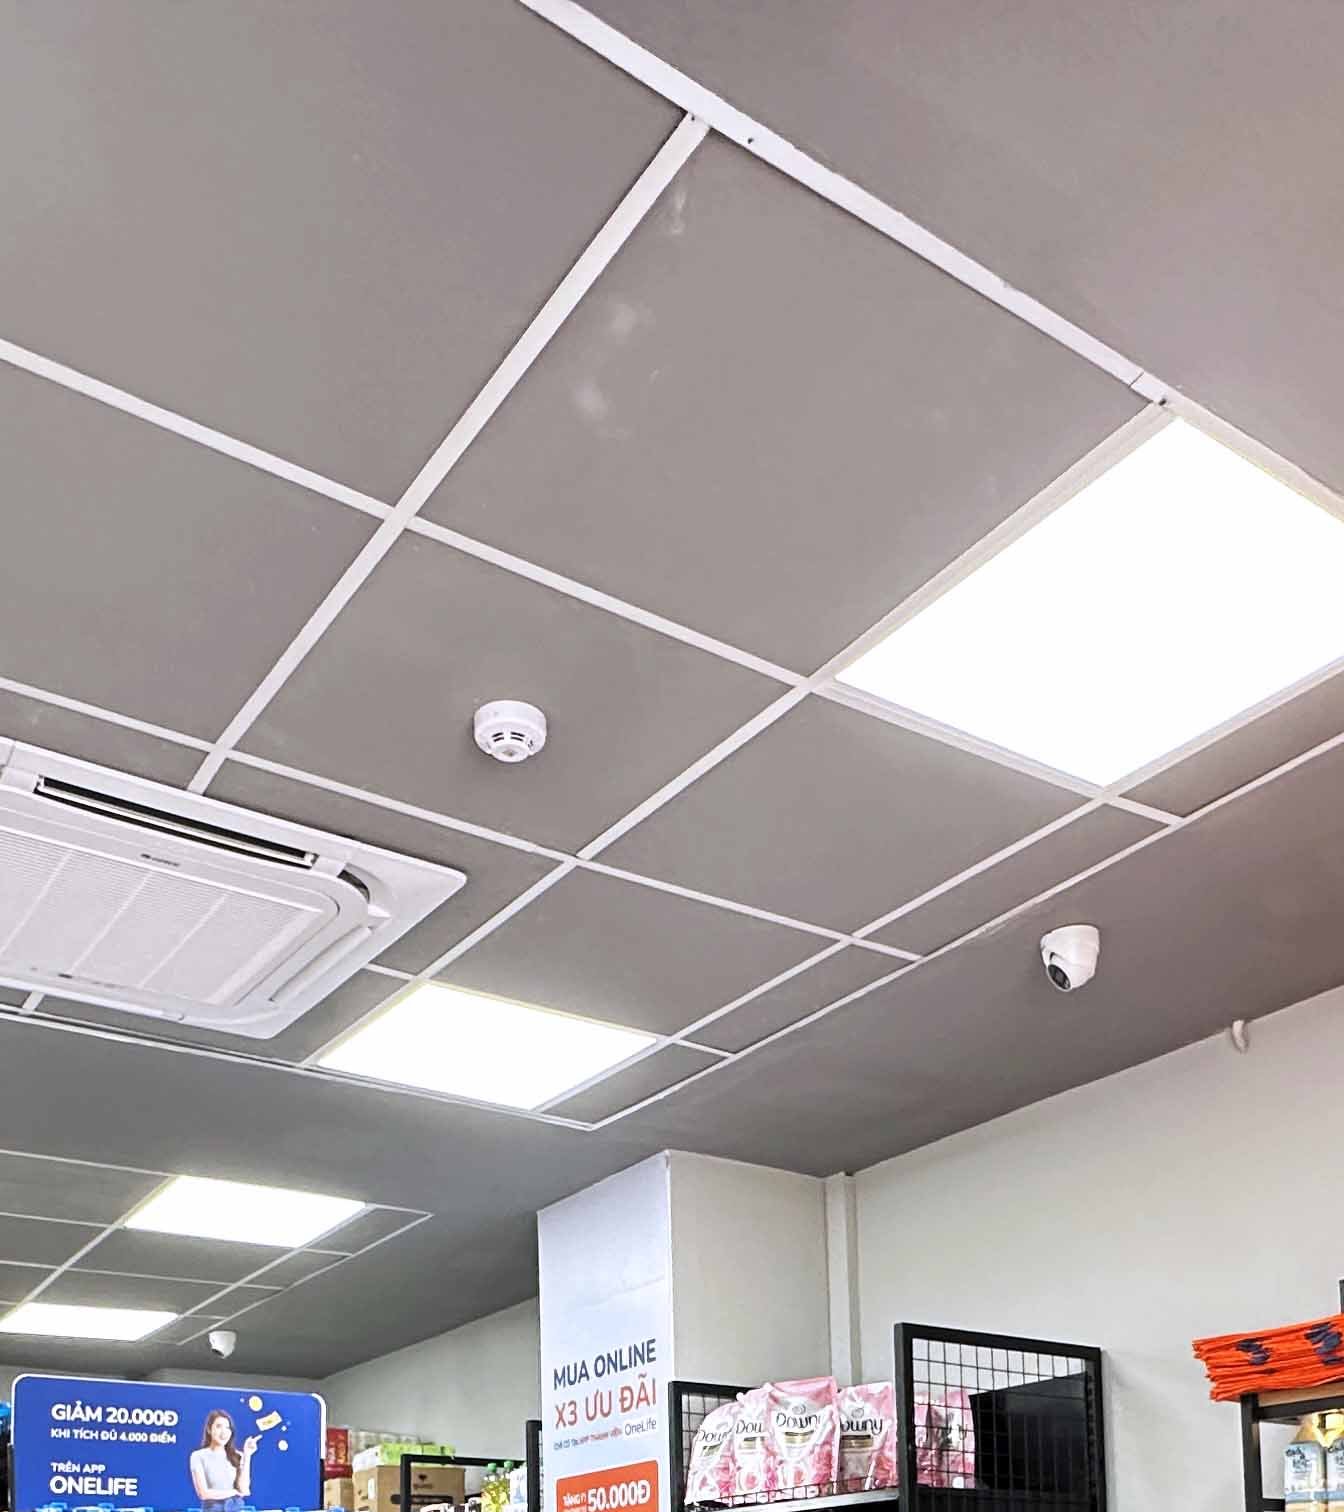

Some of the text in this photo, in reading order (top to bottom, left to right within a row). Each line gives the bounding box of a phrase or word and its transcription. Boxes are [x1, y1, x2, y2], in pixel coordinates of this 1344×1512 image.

[554, 1338, 656, 1391] MUA ONLINE
[555, 1372, 656, 1430] X3 ƯU ĐÃI
[51, 1400, 179, 1427] GIẢM 20.000Đ
[50, 1428, 70, 1440] KHI
[72, 1426, 99, 1441] TÍCH
[101, 1428, 117, 1442] ĐỦ
[119, 1431, 149, 1444] 4.000
[624, 1417, 657, 1436] OneLife
[50, 1460, 106, 1474] TRÊN APP
[49, 1476, 138, 1497] ONELIFE
[587, 1479, 651, 1512] 50.000Đ
